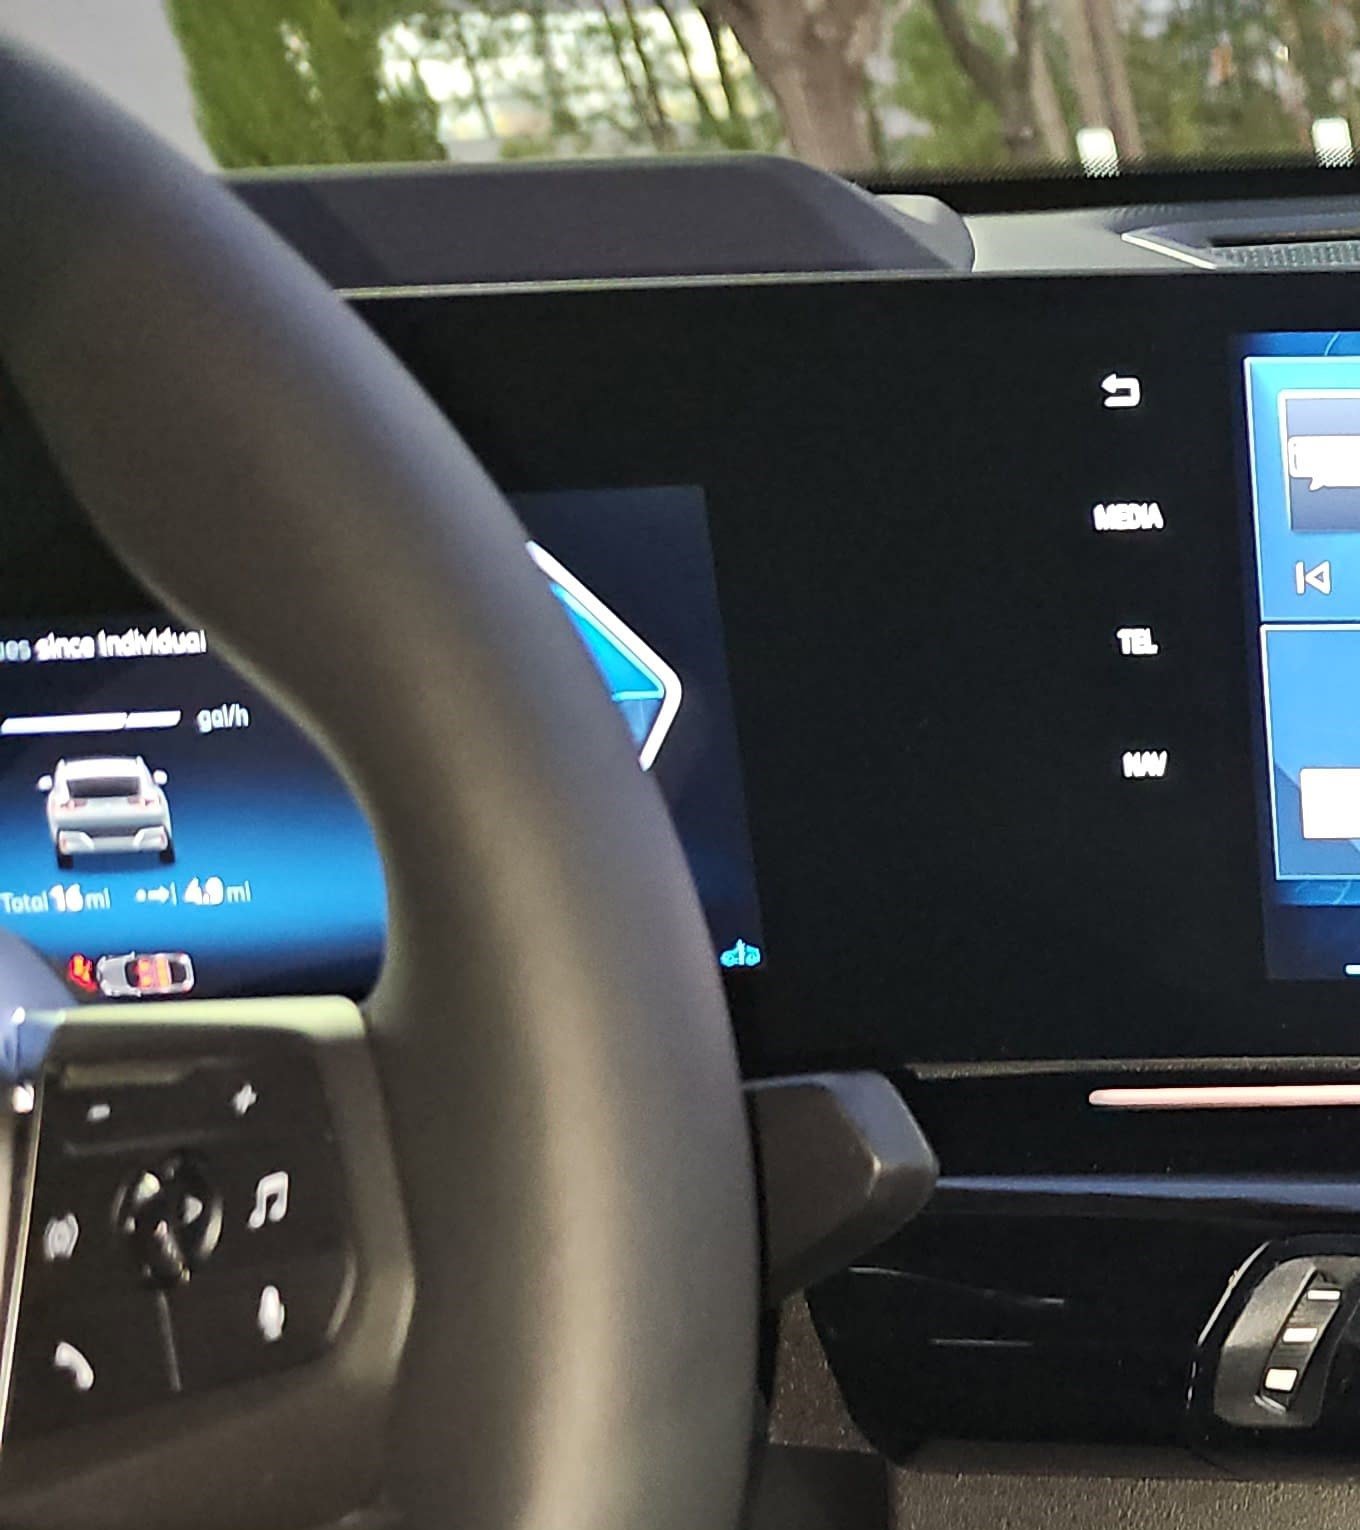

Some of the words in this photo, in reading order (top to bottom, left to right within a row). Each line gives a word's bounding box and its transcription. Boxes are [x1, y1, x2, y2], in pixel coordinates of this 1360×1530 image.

[1093, 502, 1164, 530] MEDIA
[34, 632, 95, 661] since
[1116, 627, 1158, 655] TEL
[196, 703, 249, 733] gal/h
[1122, 750, 1168, 778] NAV
[0, 890, 49, 914] Total
[50, 883, 84, 913] 16
[86, 888, 111, 911] mi
[226, 880, 252, 904] mi
